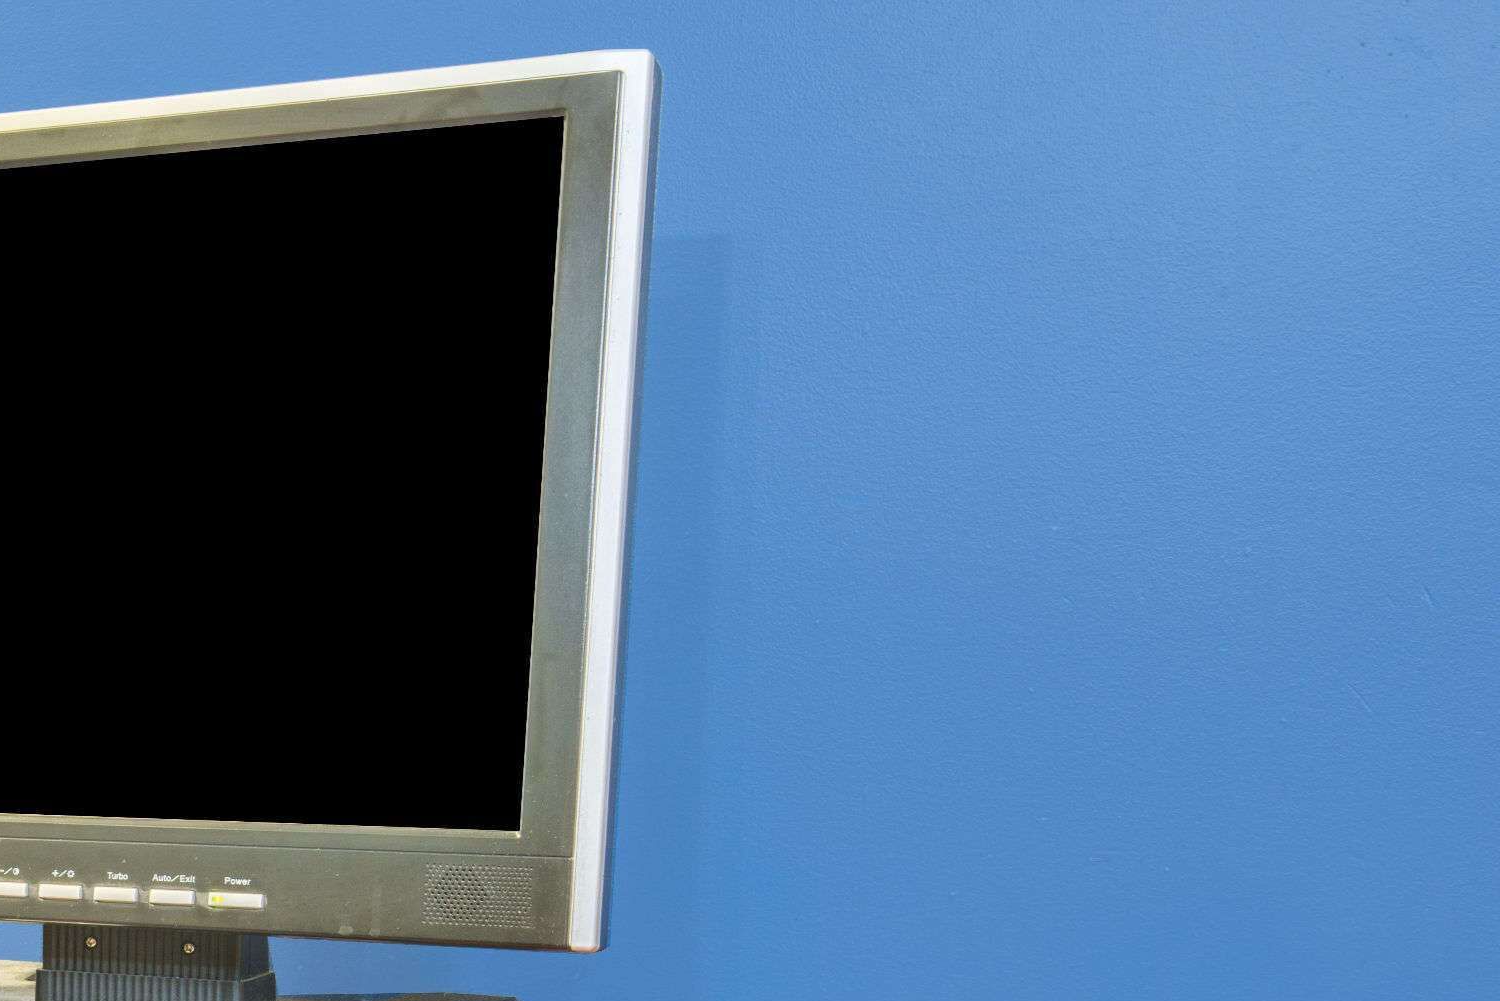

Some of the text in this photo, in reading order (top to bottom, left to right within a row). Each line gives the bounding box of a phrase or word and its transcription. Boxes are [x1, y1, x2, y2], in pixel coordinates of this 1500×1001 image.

[107, 871, 129, 881] Turbo
[152, 873, 196, 884] Auto/Exit
[224, 876, 251, 886] Power
